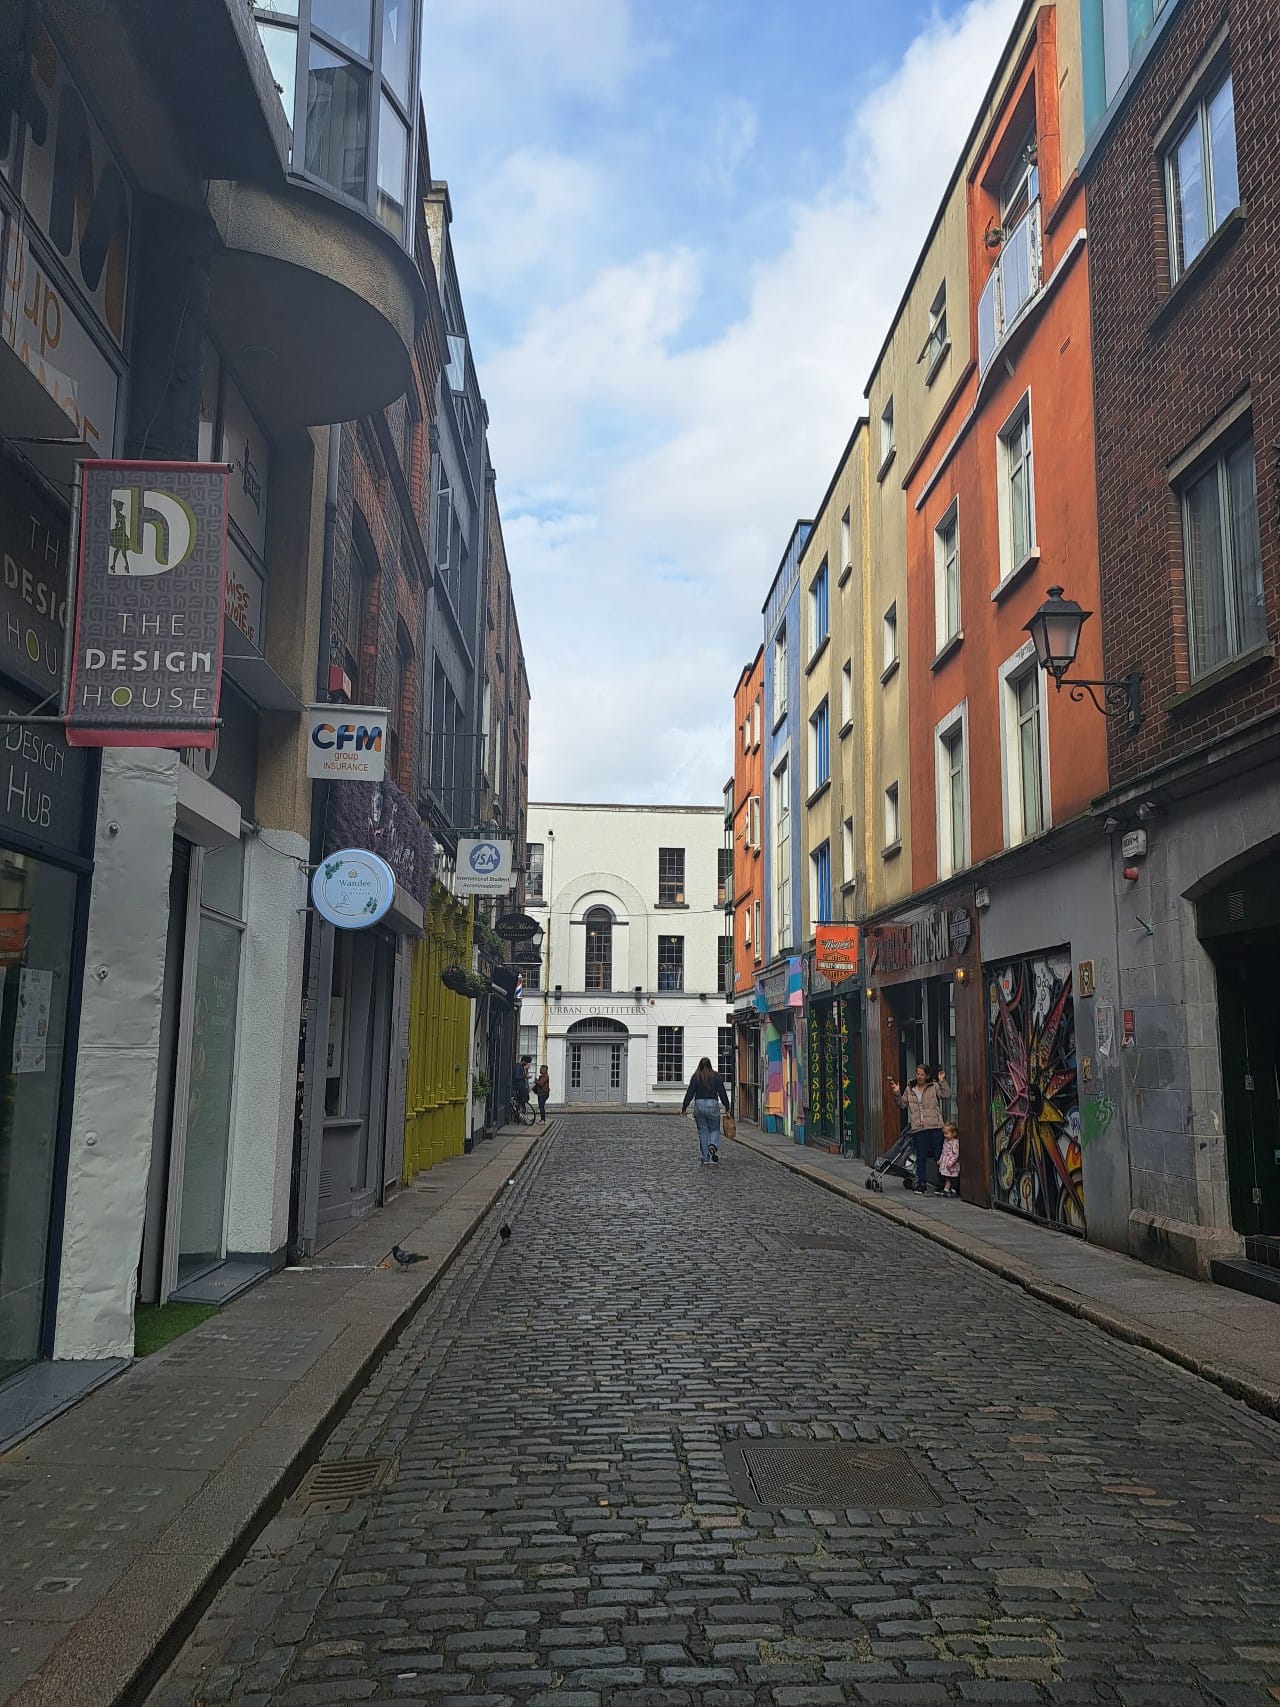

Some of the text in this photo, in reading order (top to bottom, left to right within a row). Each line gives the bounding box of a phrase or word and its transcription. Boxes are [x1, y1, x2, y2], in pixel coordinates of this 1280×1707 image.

[30, 515, 67, 572] TH
[117, 612, 185, 636] THE
[7, 611, 58, 676] HOU
[85, 648, 211, 673] DESIGN
[82, 686, 207, 709] HOUSE
[6, 709, 64, 776] DESIGN
[312, 723, 382, 752] CFM
[323, 762, 369, 772] INSURANCE
[334, 751, 358, 761] group
[7, 765, 52, 828] HUB
[475, 854, 495, 866] ISA
[550, 1006, 646, 1014] URBAN OUTFITTERS
[812, 1077, 820, 1123] SHOP
